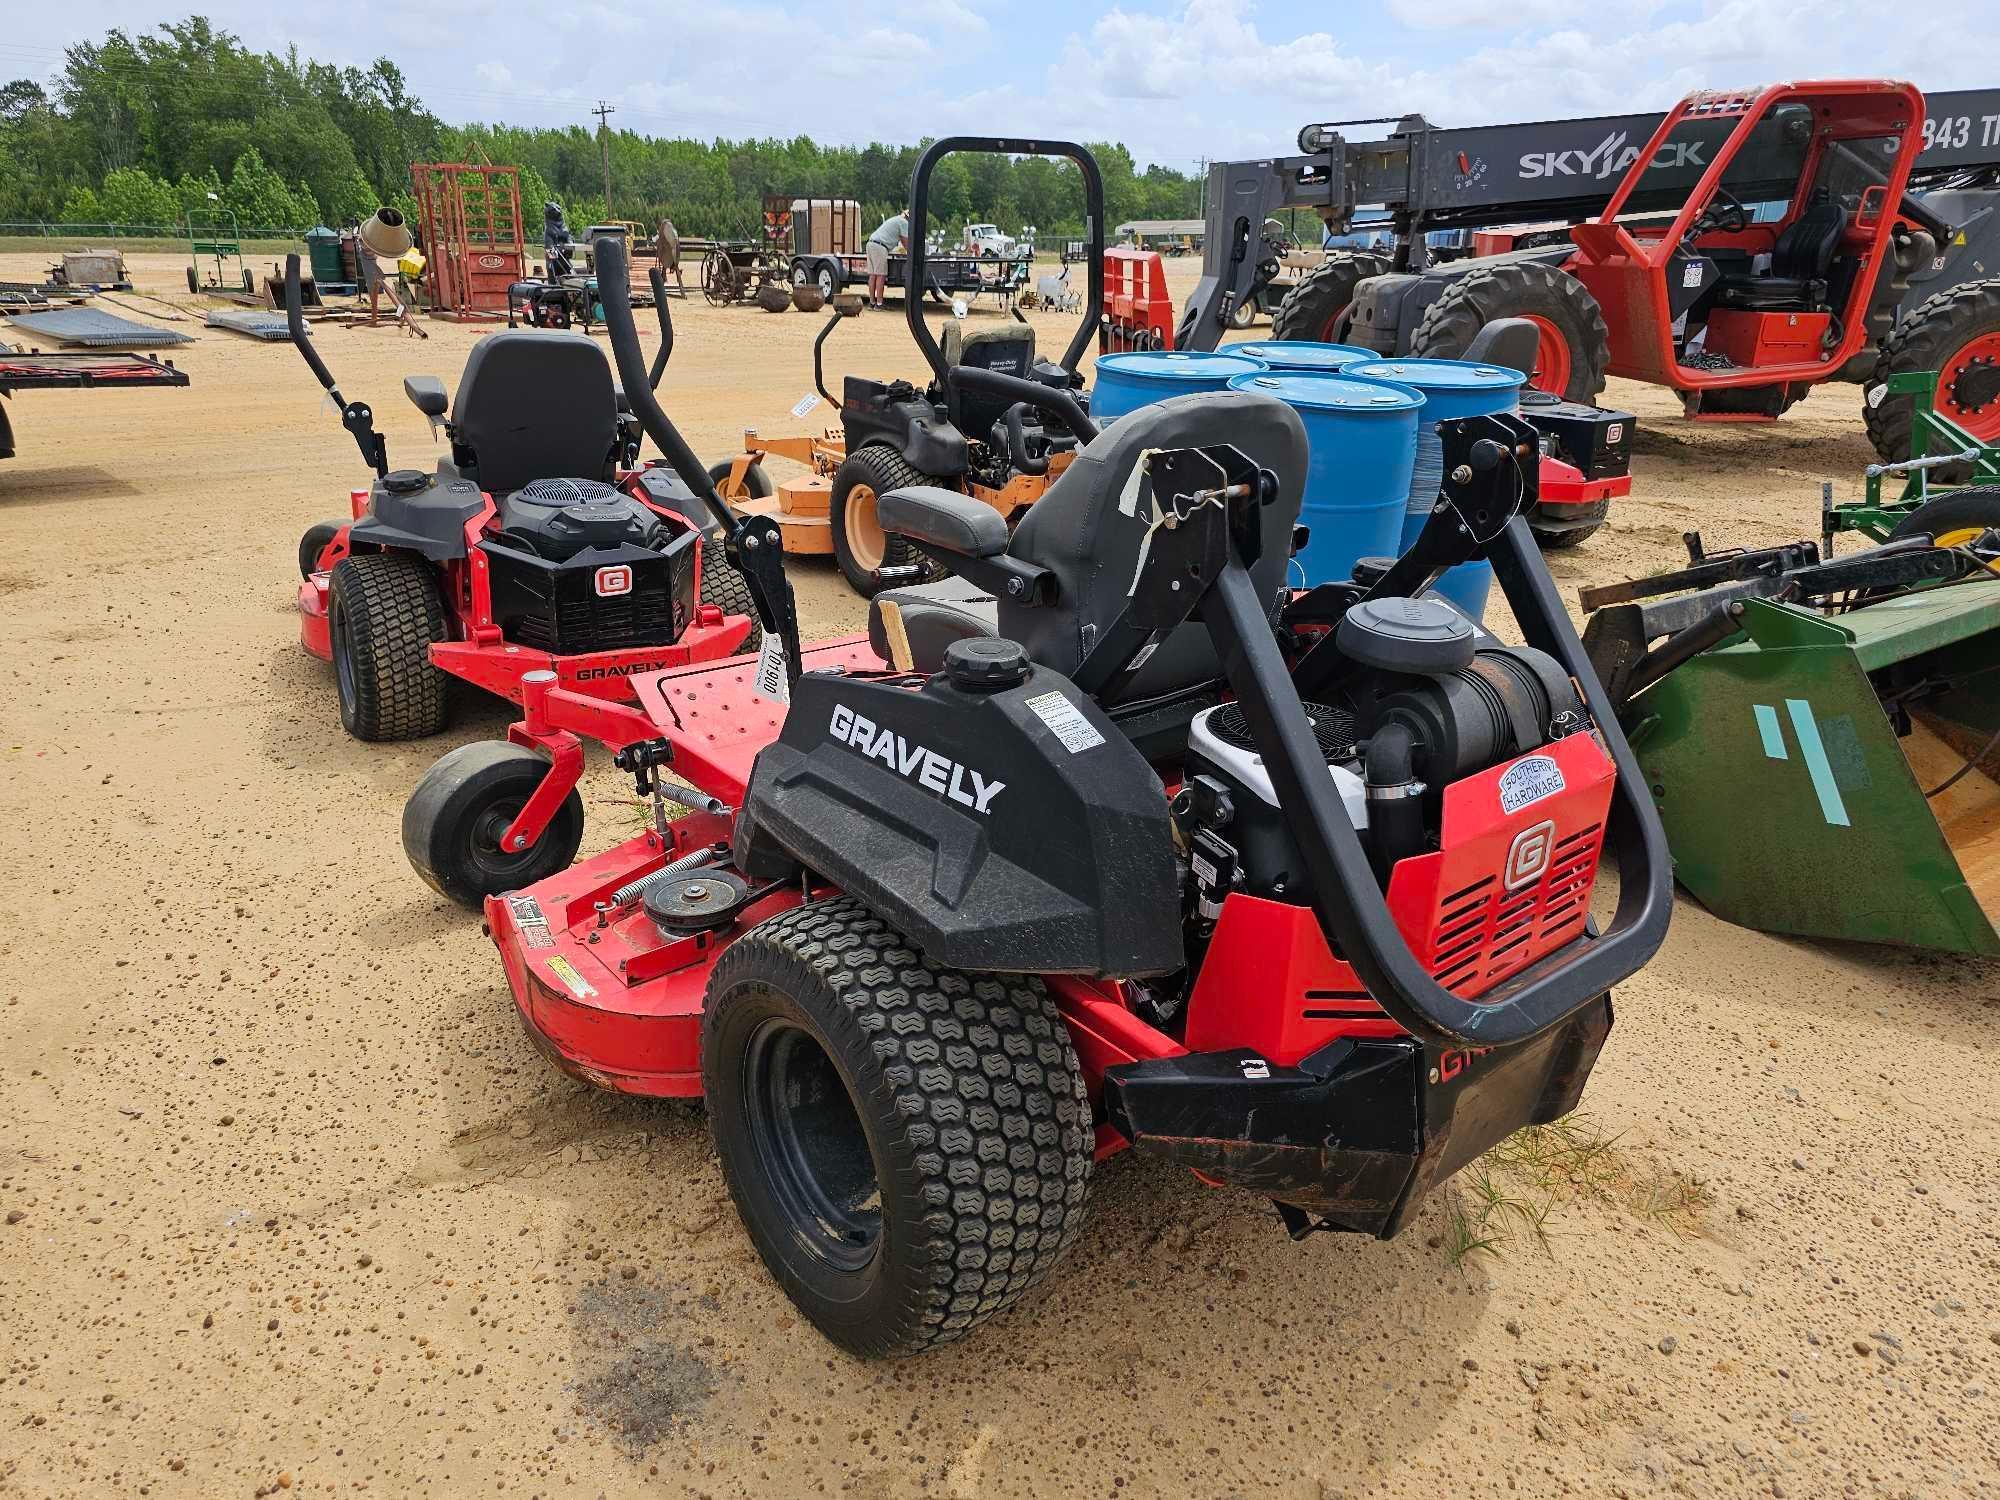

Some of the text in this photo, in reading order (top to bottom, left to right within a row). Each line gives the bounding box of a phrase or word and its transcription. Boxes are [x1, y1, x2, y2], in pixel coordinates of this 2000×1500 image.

[1519, 131, 1705, 179] SKYJACK
[576, 661, 667, 681] GRAVELY
[763, 649, 782, 694] 101900
[829, 703, 1006, 815] GRAVELY
[1505, 761, 1552, 791] SOUTHERN
[1504, 772, 1562, 809] HARDWARE
